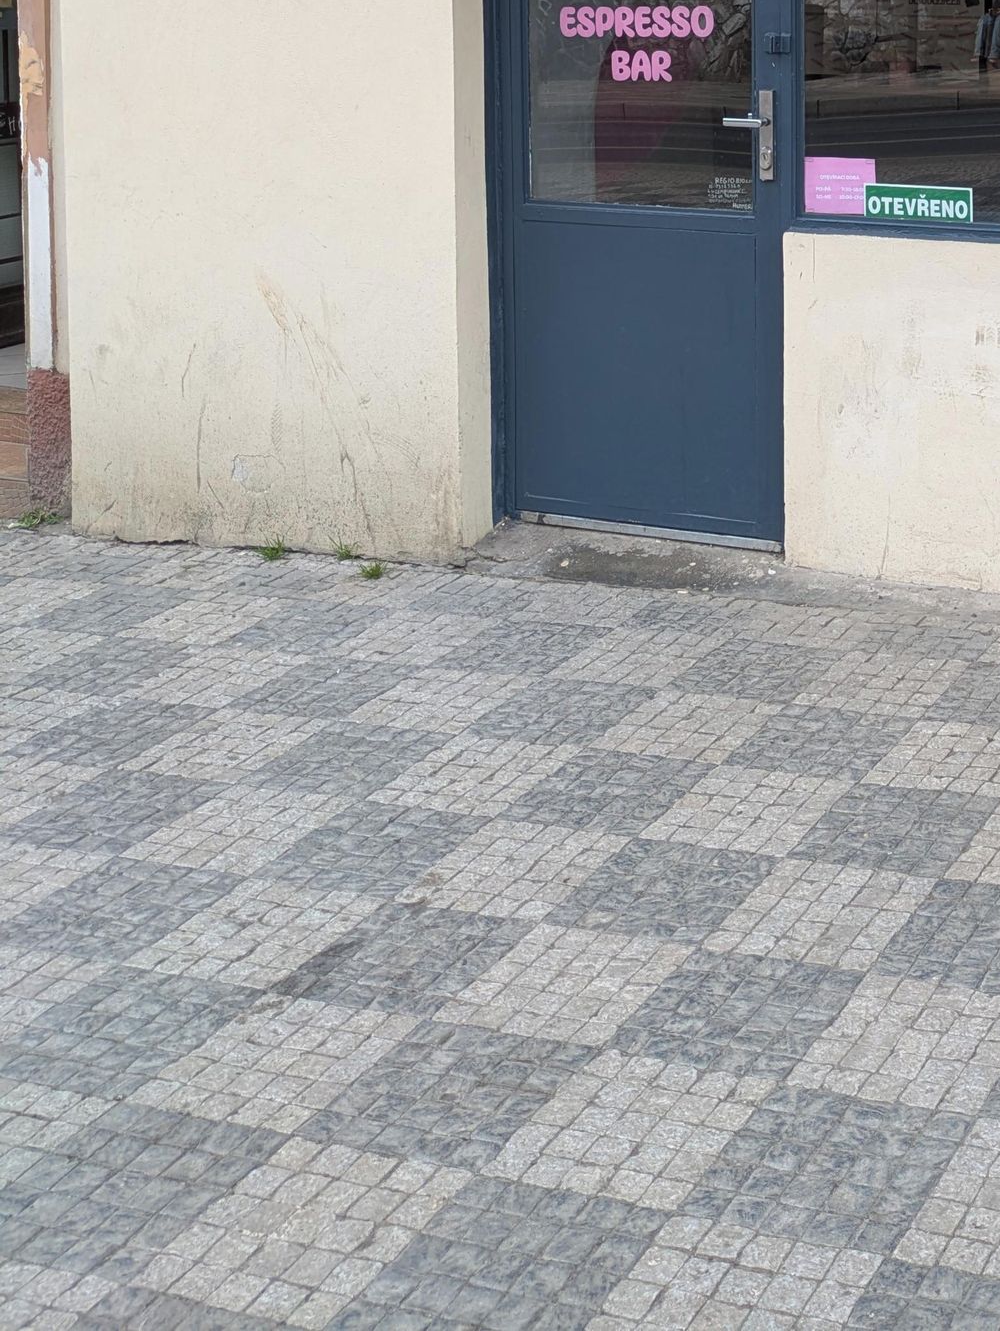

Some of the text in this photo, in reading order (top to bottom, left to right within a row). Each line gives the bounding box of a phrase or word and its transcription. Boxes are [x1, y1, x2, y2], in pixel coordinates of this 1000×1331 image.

[558, 5, 715, 39] ESPRESSO
[610, 49, 672, 83] BAR
[867, 193, 969, 220] OTEVŘENO
